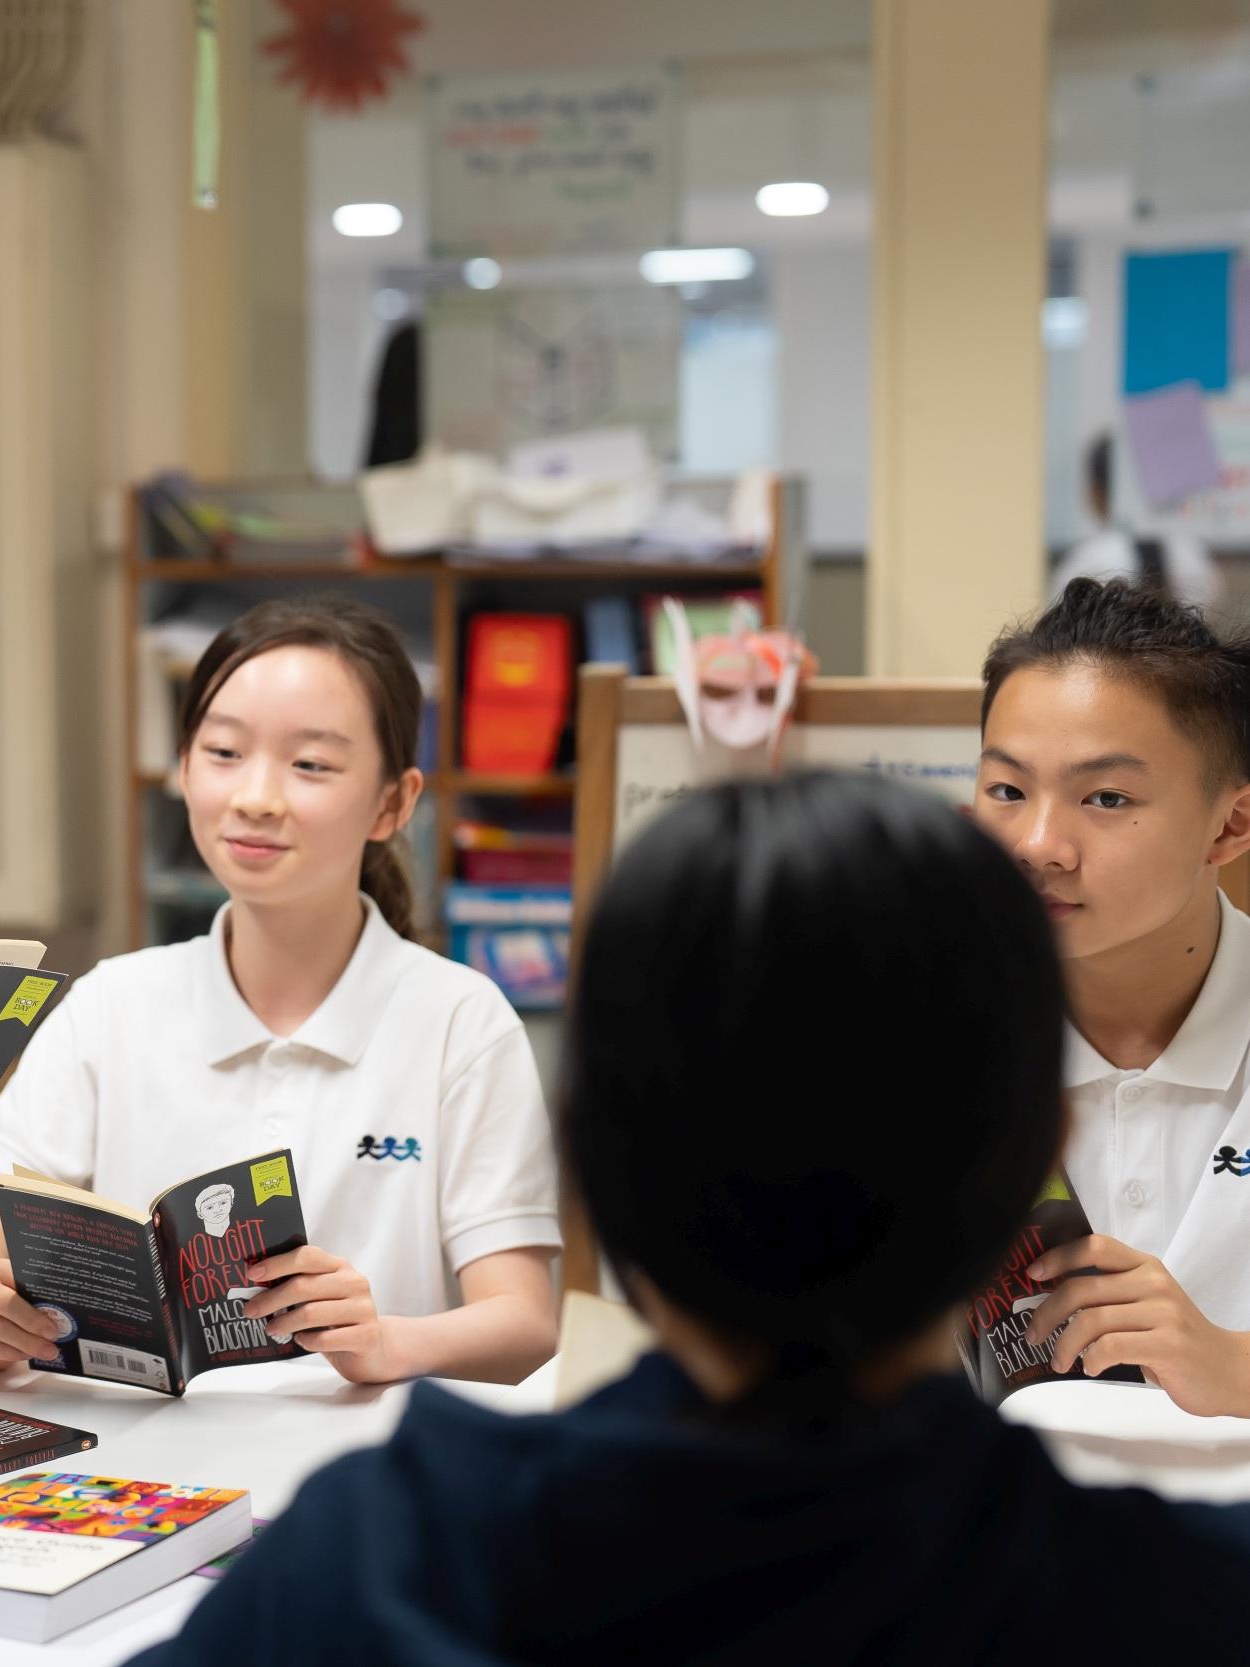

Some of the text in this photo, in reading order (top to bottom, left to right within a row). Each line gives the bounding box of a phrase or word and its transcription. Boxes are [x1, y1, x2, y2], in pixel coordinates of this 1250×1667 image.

[15, 997, 40, 1006] BOOK
[13, 1004, 31, 1012] DAY
[259, 1176, 284, 1187] BOOK
[263, 1184, 280, 1192] DAY
[180, 1220, 267, 1272] NOUGHT
[198, 1300, 246, 1327] MALO
[203, 1318, 268, 1354] BLACKMAN
